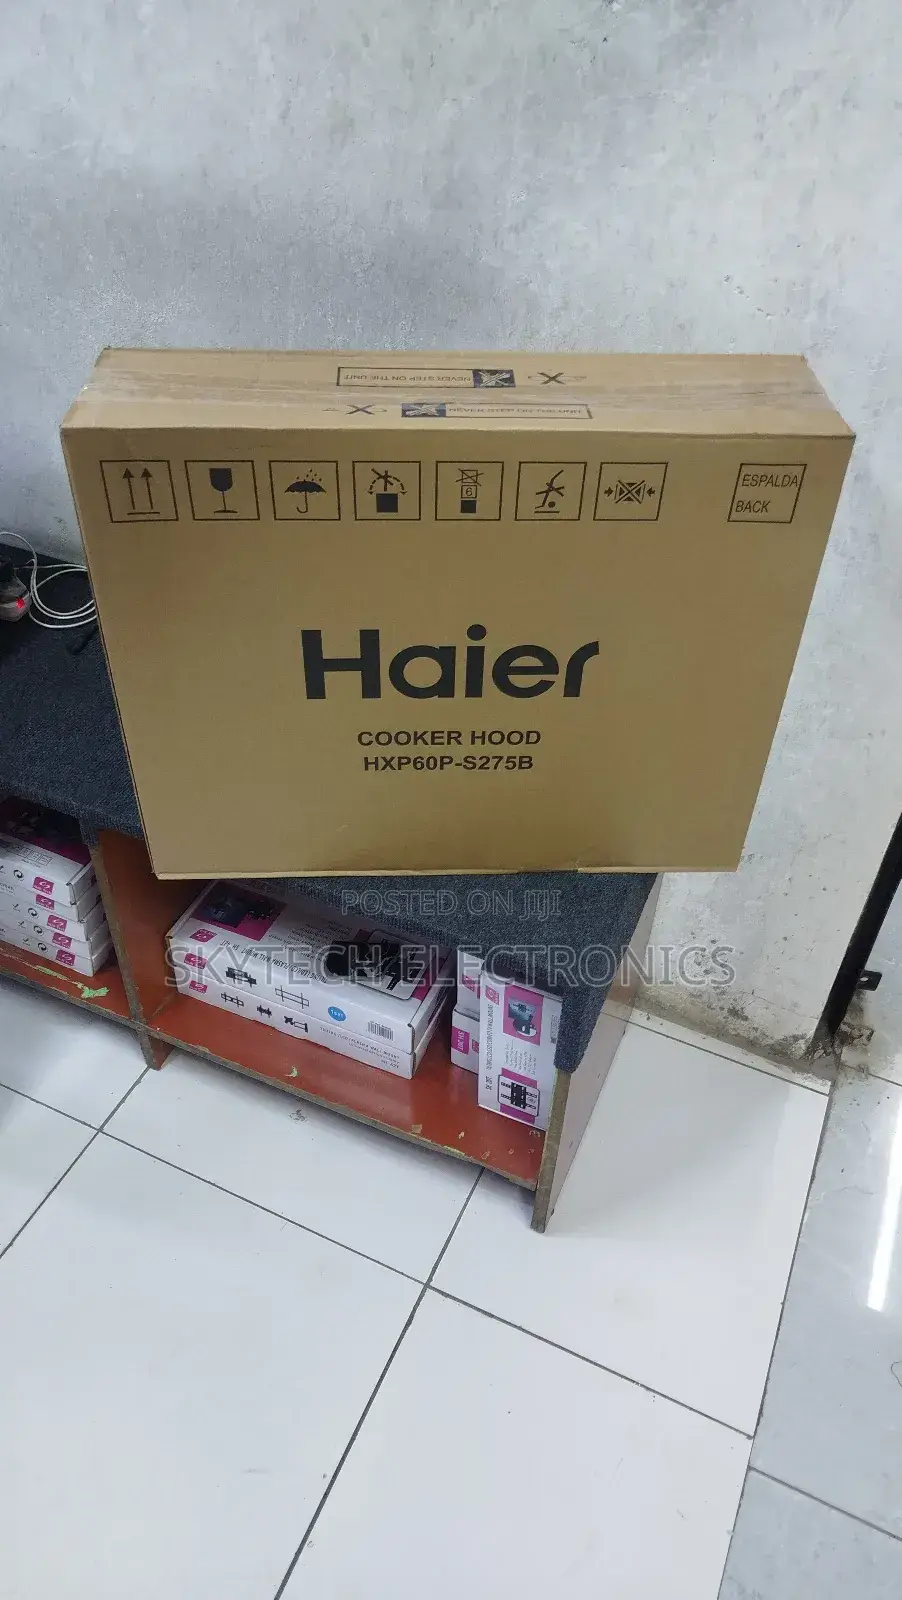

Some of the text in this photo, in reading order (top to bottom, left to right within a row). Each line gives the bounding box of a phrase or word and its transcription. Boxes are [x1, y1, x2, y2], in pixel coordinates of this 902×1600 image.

[741, 474, 799, 488] ESPALDA
[465, 487, 473, 497] 6
[735, 500, 771, 513] BACK
[301, 623, 600, 700] Haier
[357, 730, 542, 747] COOKER HOOD
[363, 755, 534, 771] HXP60P-S275B
